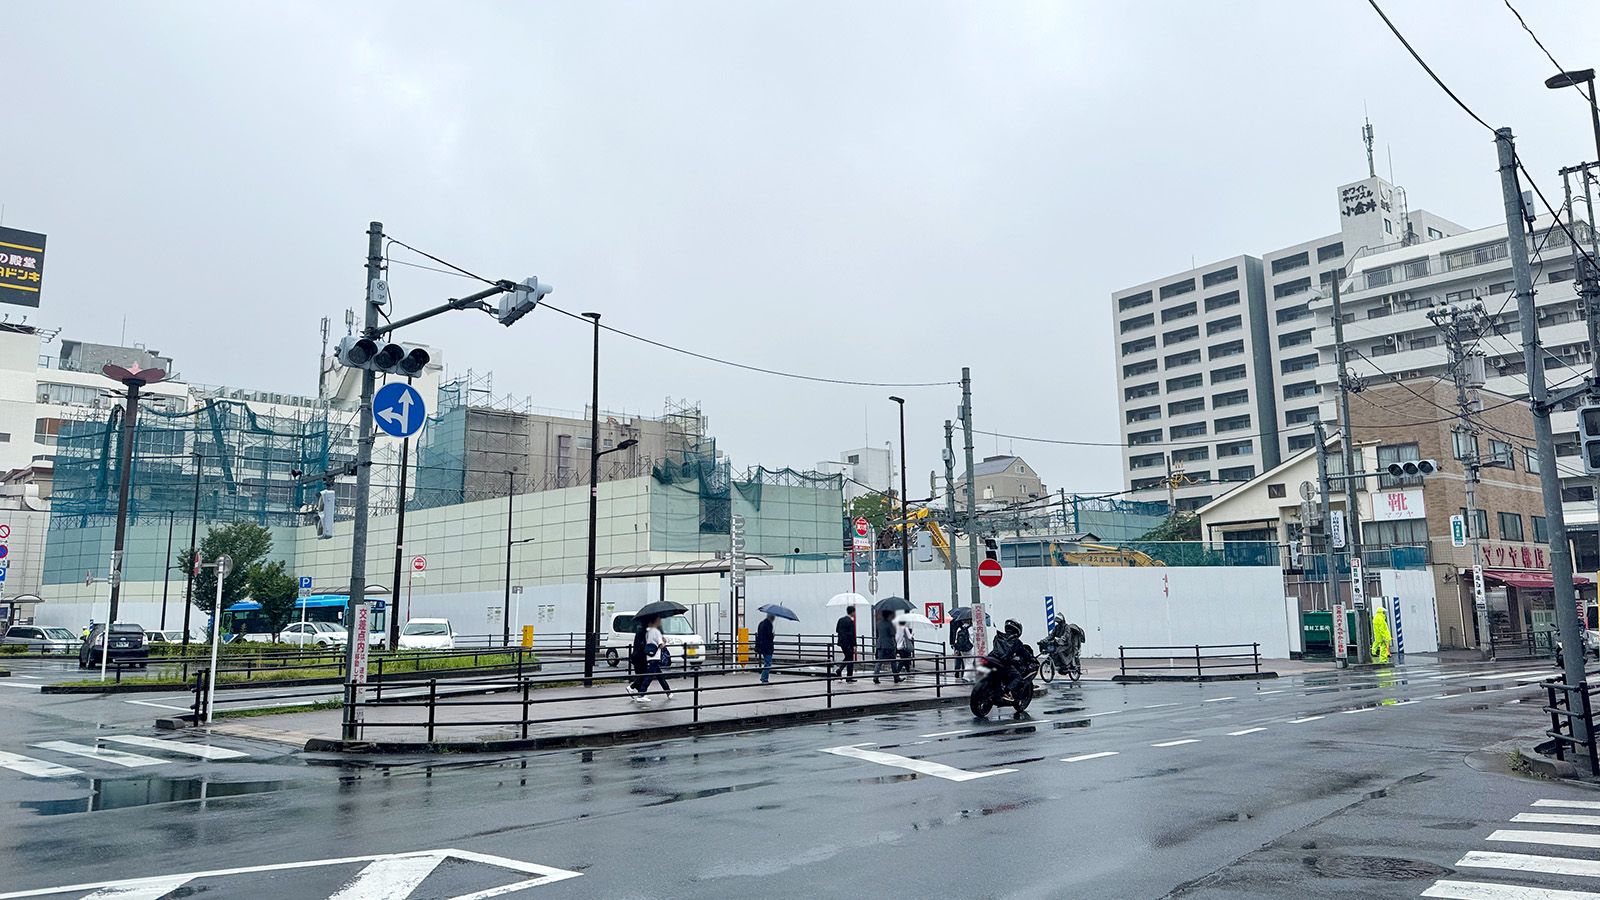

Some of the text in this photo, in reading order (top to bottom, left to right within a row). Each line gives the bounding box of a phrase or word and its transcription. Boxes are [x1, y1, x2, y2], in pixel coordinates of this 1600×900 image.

[1342, 184, 1367, 196] ホワイト
[1343, 190, 1374, 203] キャッスル
[1342, 198, 1377, 217] 小金井
[0, 253, 36, 269] の殿堂
[1388, 492, 1409, 512] 靴
[1384, 510, 1414, 518] マツヤ
[302, 577, 310, 587] P
